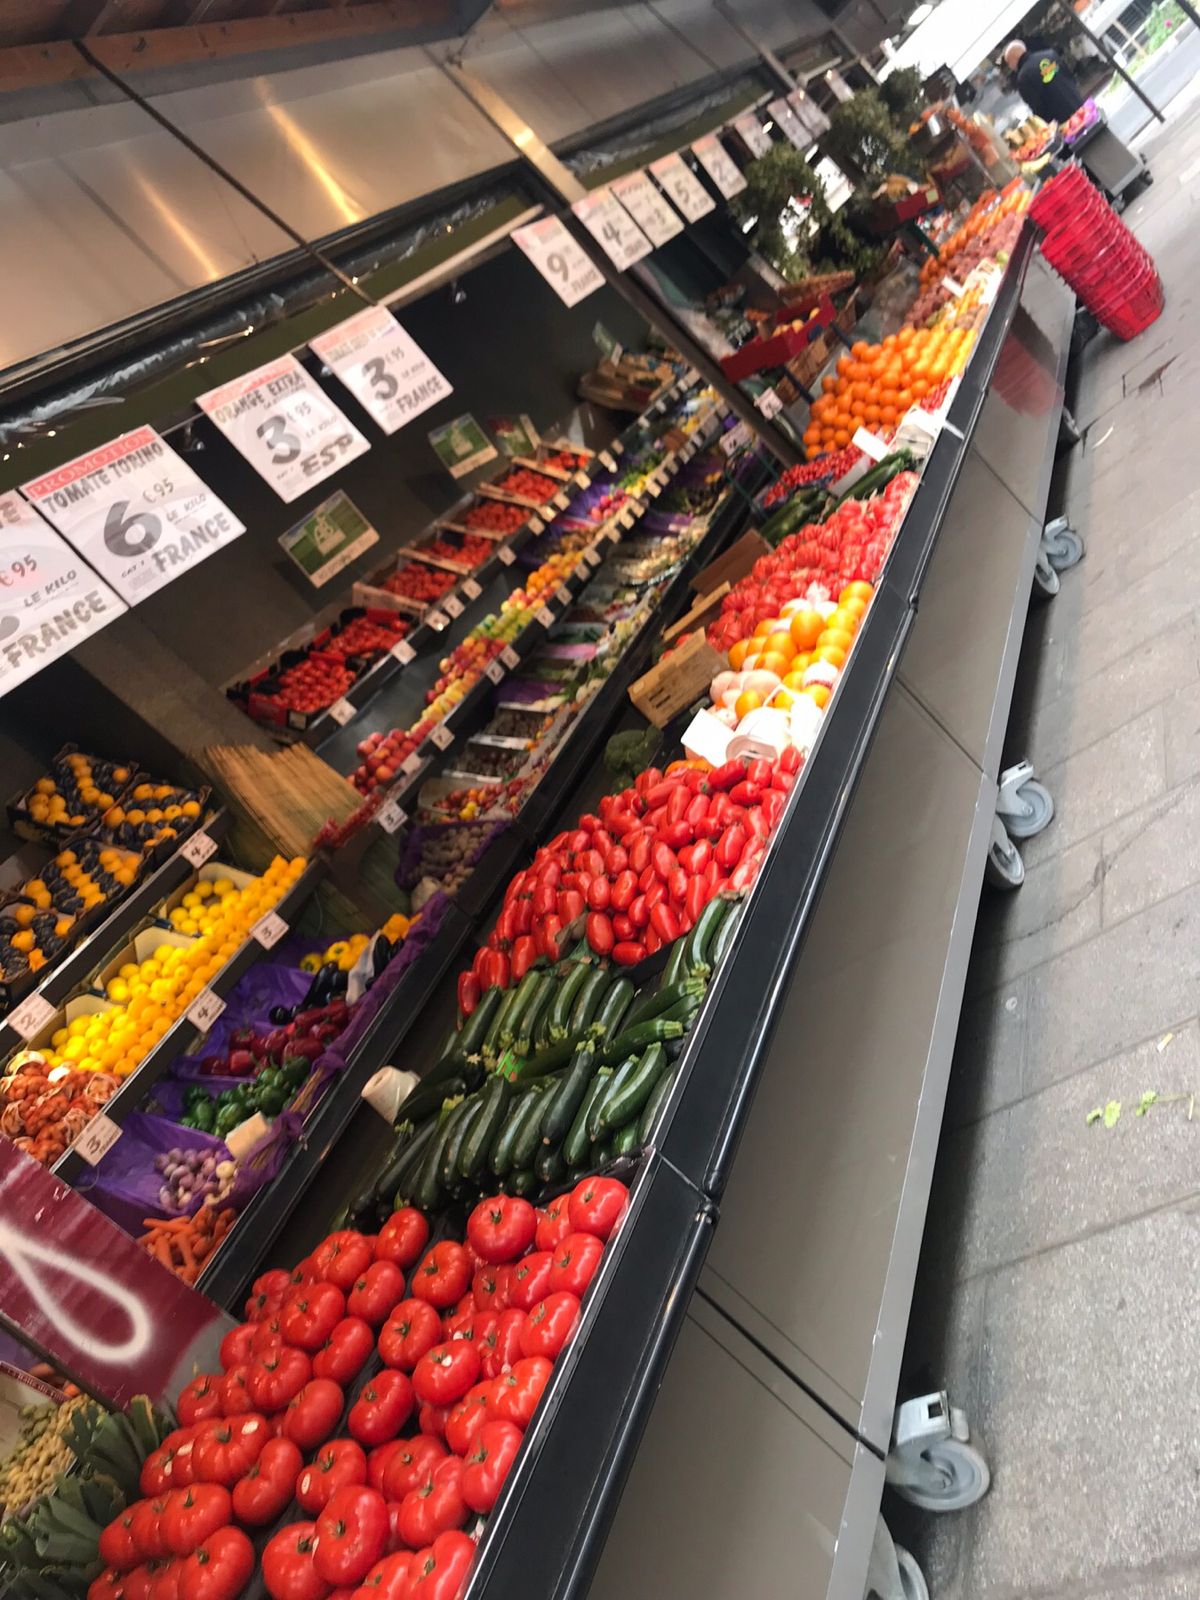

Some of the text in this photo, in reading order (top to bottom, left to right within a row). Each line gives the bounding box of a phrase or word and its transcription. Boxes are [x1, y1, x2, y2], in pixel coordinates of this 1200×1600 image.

[601, 221, 622, 246] 4
[547, 252, 569, 282] 9
[362, 356, 399, 400] 3
[396, 375, 442, 414] FRANCE
[215, 391, 265, 424] ORANGE
[256, 415, 302, 465] 3
[300, 433, 354, 478] ESP
[30, 432, 153, 498] PROMOTION
[42, 441, 164, 514] TOMATE TORINO
[103, 500, 162, 557] 6
[151, 511, 231, 573] FRANCE
[24, 569, 78, 608] LE KILO
[3, 590, 107, 668] FRANCE
[191, 848, 202, 858] 4
[20, 1013, 36, 1032] 2
[197, 1006, 209, 1019] 4
[86, 1135, 102, 1155] 3
